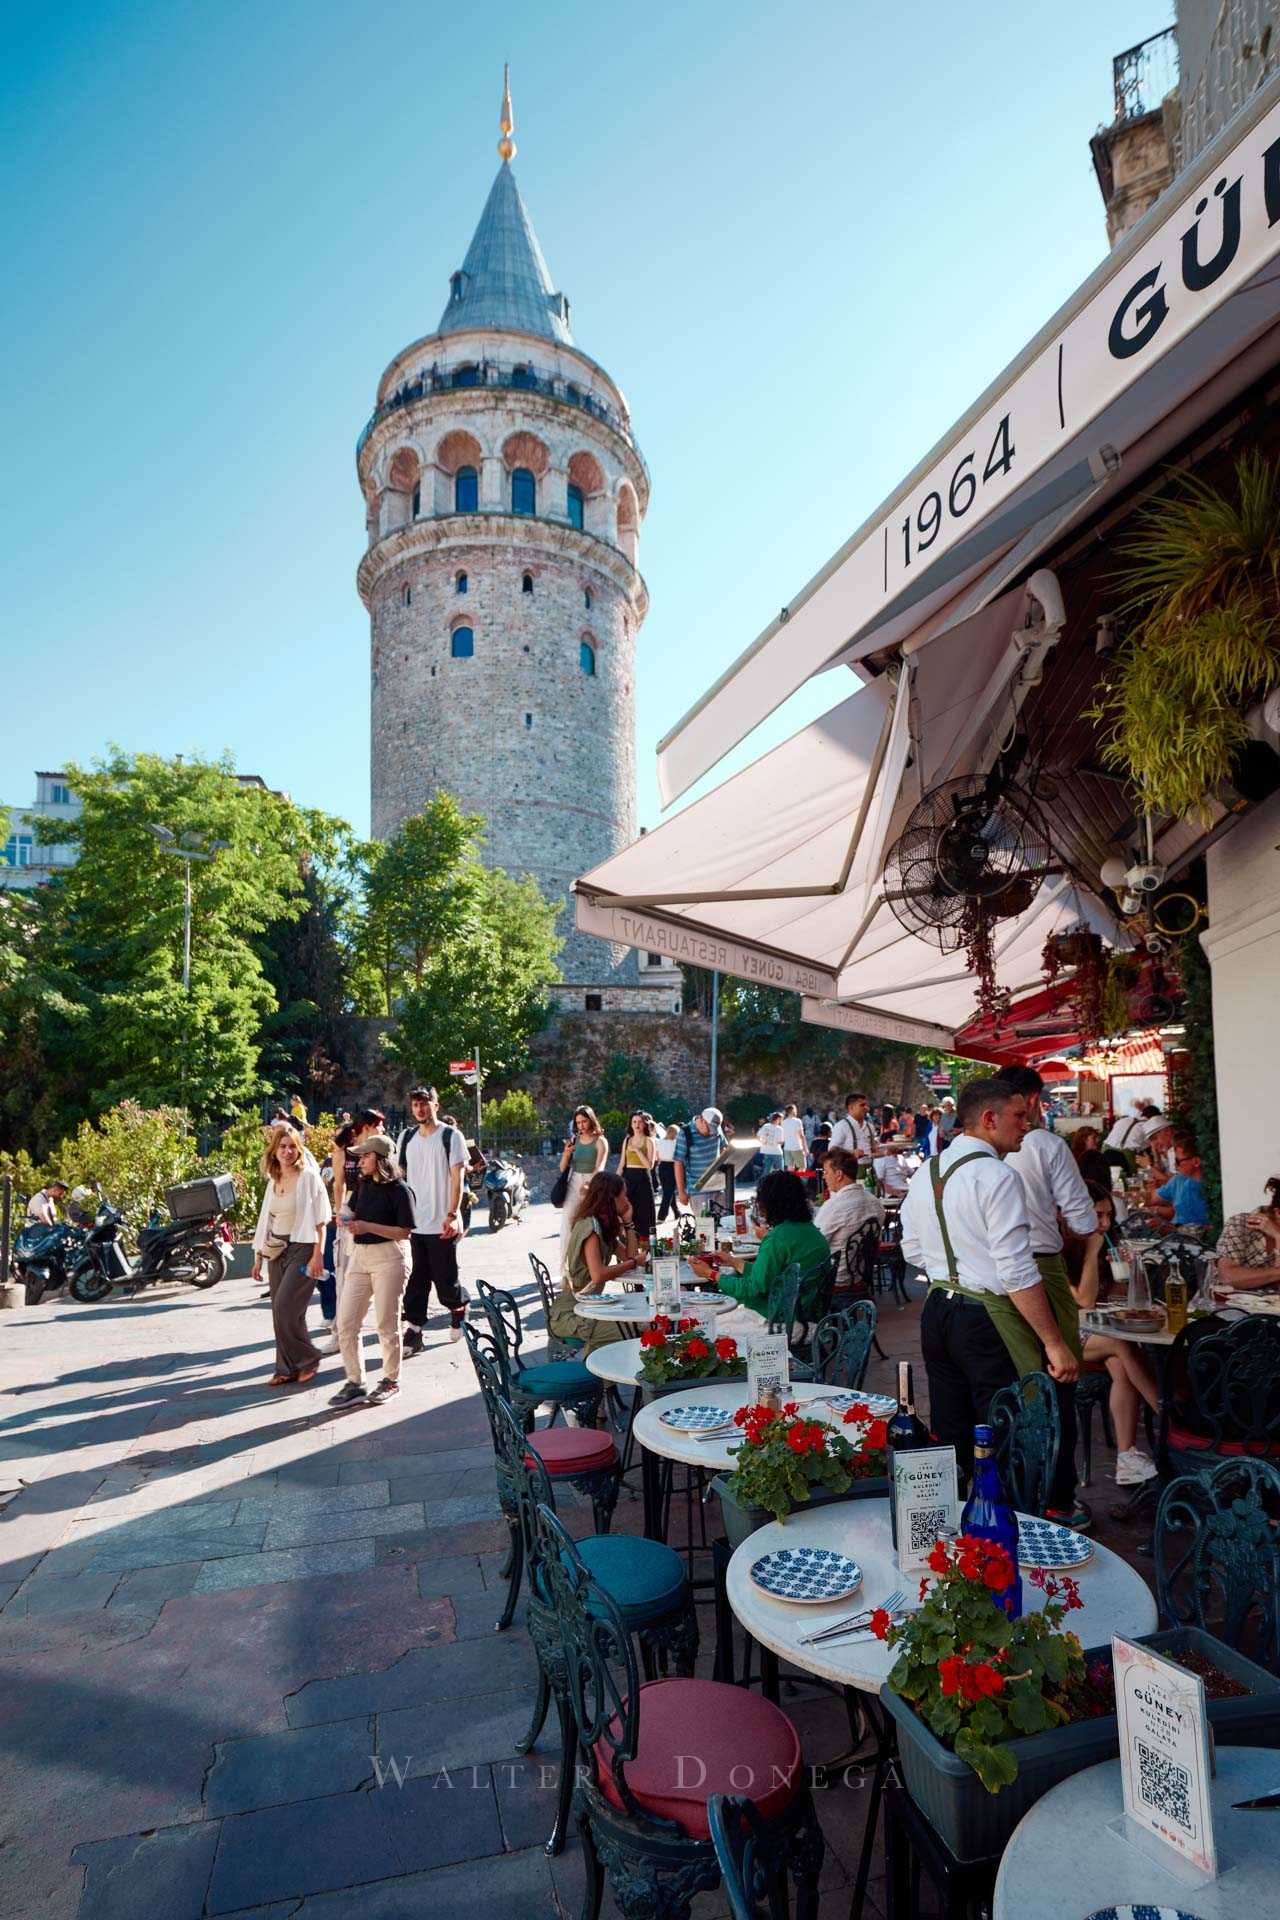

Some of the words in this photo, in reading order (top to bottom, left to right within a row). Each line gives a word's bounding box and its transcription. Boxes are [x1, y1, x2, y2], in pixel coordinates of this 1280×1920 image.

[902, 412, 1016, 568] 1964
[909, 1472, 943, 1481] GÜNEY
[1134, 1688, 1182, 1722] GÜNEY
